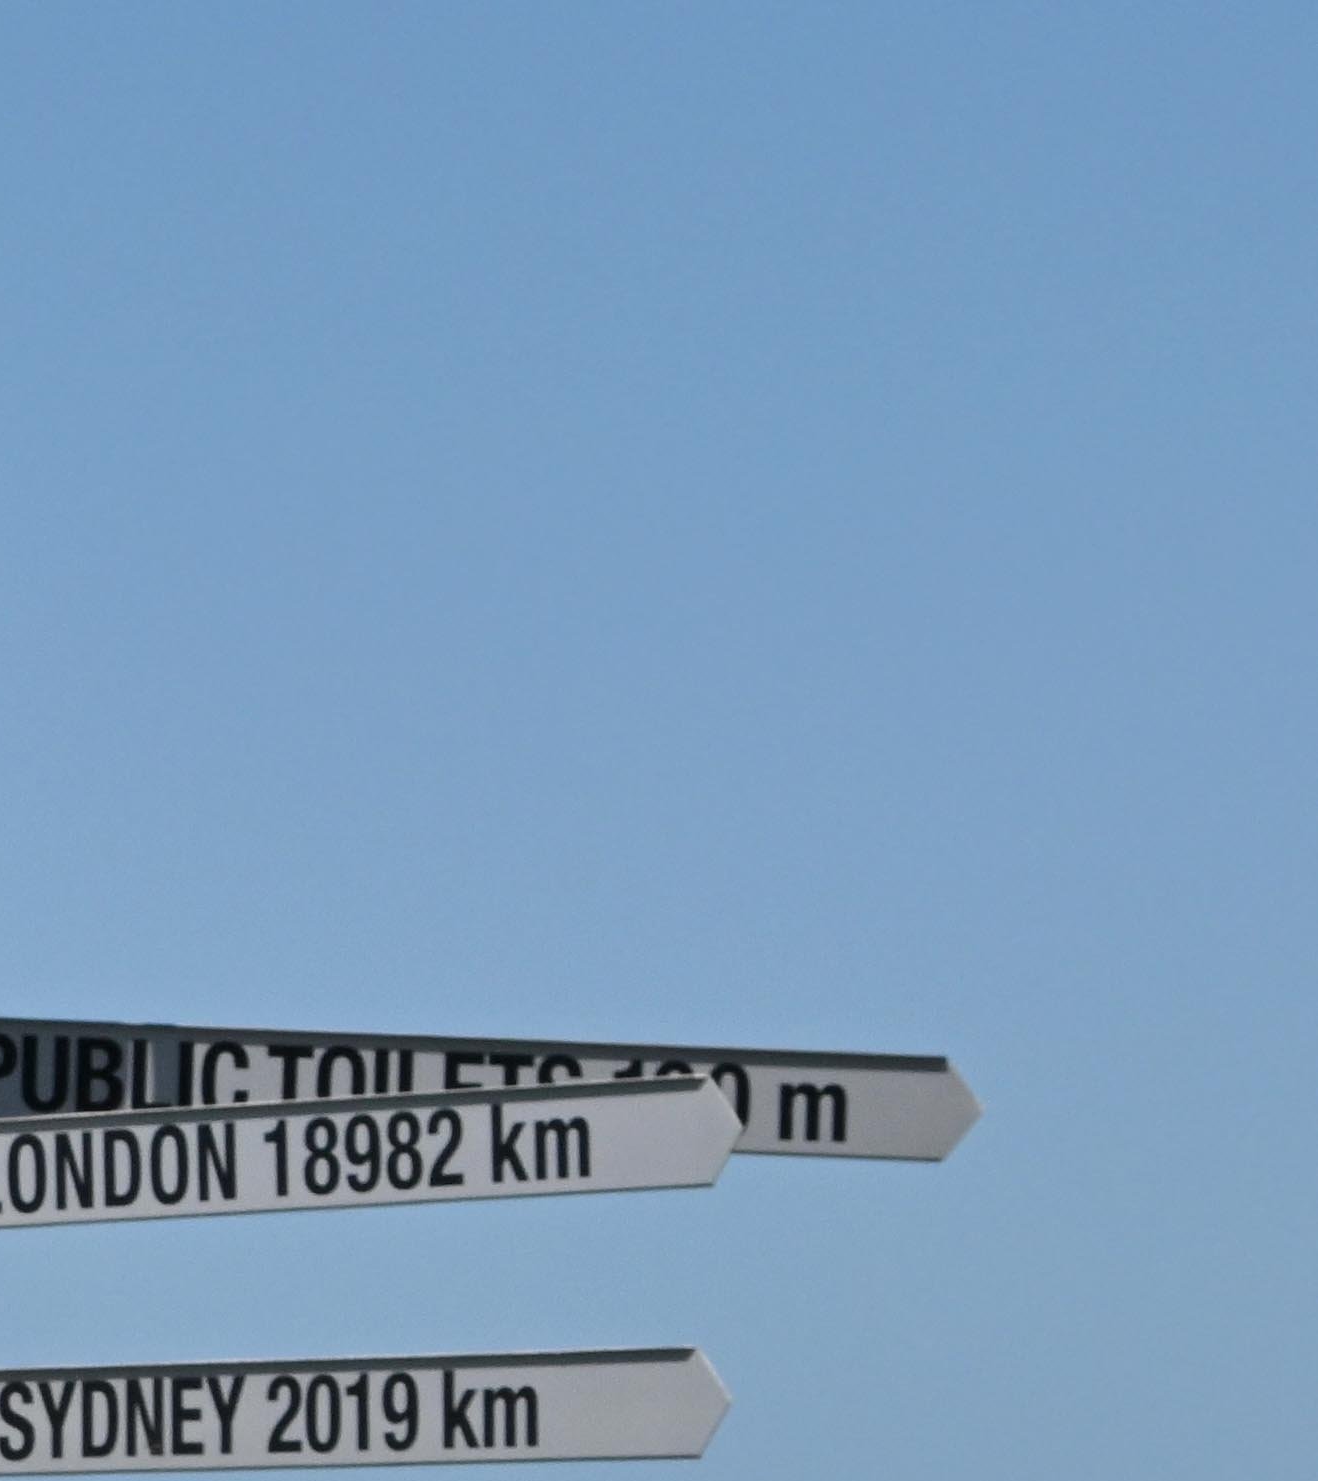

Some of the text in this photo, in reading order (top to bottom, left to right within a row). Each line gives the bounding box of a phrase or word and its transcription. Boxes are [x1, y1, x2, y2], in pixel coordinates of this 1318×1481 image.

[265, 1110, 464, 1198] 18982
[490, 1102, 591, 1183] km
[778, 1081, 848, 1142] m
[267, 1372, 419, 1453] 2019
[443, 1369, 539, 1449] km
